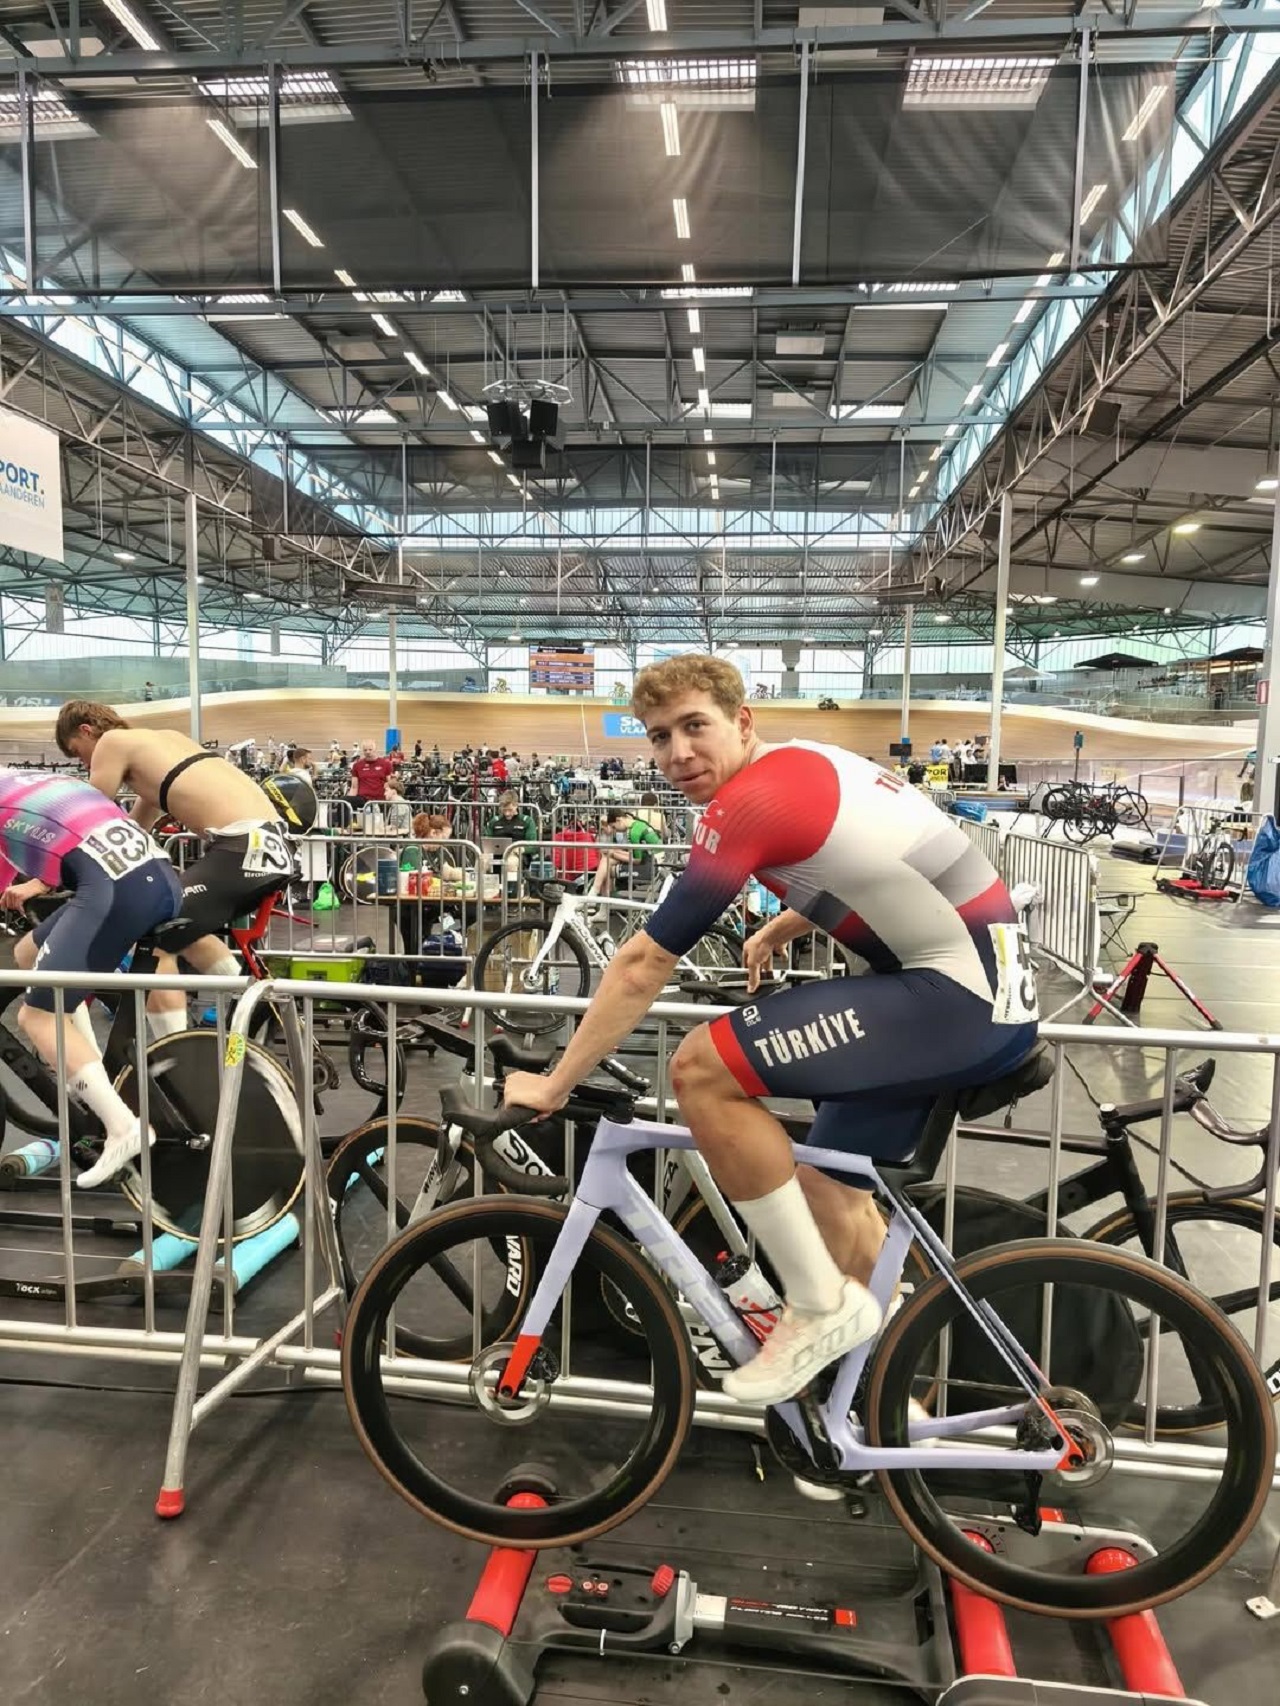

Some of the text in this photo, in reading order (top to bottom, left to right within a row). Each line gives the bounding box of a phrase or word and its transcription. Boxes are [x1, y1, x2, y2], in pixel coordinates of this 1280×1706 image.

[105, 825, 146, 862] 63
[261, 835, 288, 870] 62
[754, 1008, 866, 1067] TÜRKİYE
